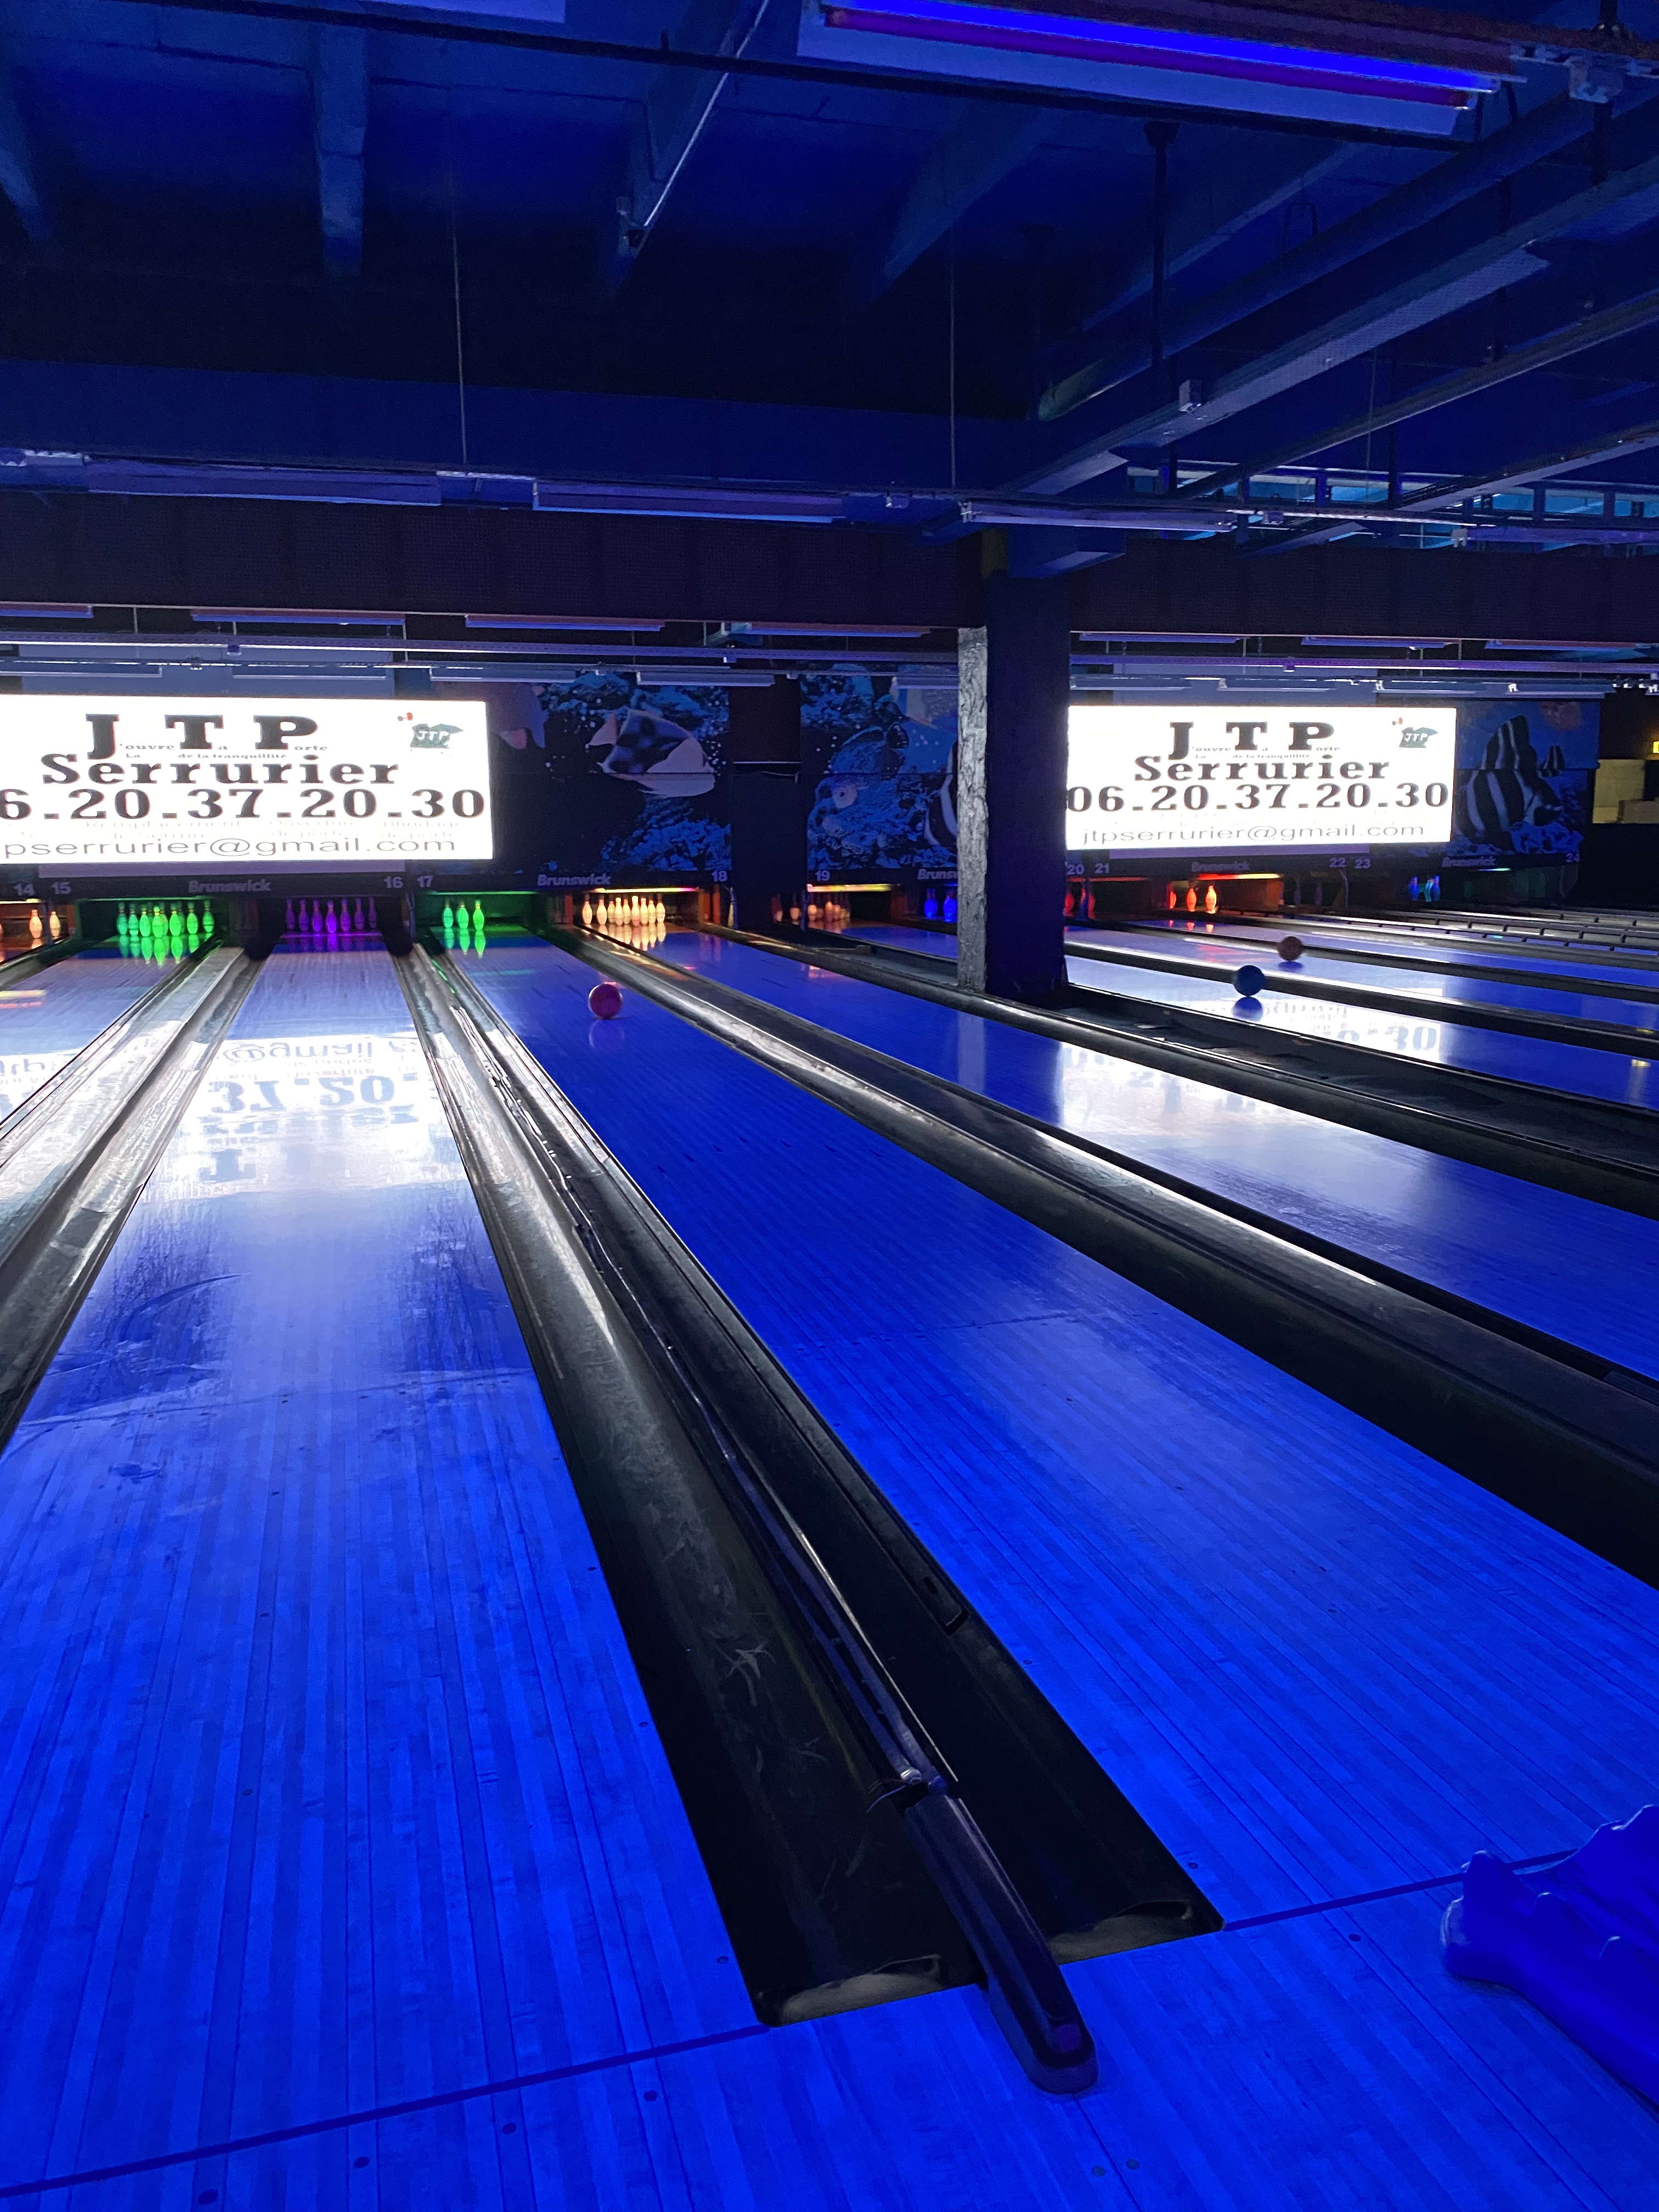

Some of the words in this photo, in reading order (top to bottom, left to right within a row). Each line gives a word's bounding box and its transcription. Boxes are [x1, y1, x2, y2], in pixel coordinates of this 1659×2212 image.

[86, 713, 120, 760] J
[165, 714, 224, 750] T
[253, 715, 318, 751] P
[416, 730, 450, 741] JTP
[1167, 721, 1194, 761] J
[1226, 721, 1267, 751] T
[1288, 721, 1334, 751] P
[1404, 732, 1429, 742] JTP
[41, 753, 399, 785] Serrurier
[1135, 754, 1390, 781] Serrurier
[1066, 782, 1449, 812] 06.20.37.20.30
[1082, 823, 1424, 845] jtpserrurier@gmail.com
[1094, 863, 1110, 874] 21
[1329, 857, 1346, 868] 22
[1354, 859, 1370, 869] 23
[712, 870, 728, 882] 18
[815, 870, 830, 881] 19
[917, 868, 958, 880] Bruns
[1066, 864, 1085, 875] 20
[188, 879, 271, 893] Brunswick
[385, 876, 403, 888] 16
[417, 874, 433, 888] 17
[538, 873, 612, 886] Brunswick
[14, 883, 35, 896] 14
[52, 881, 71, 894] 15
